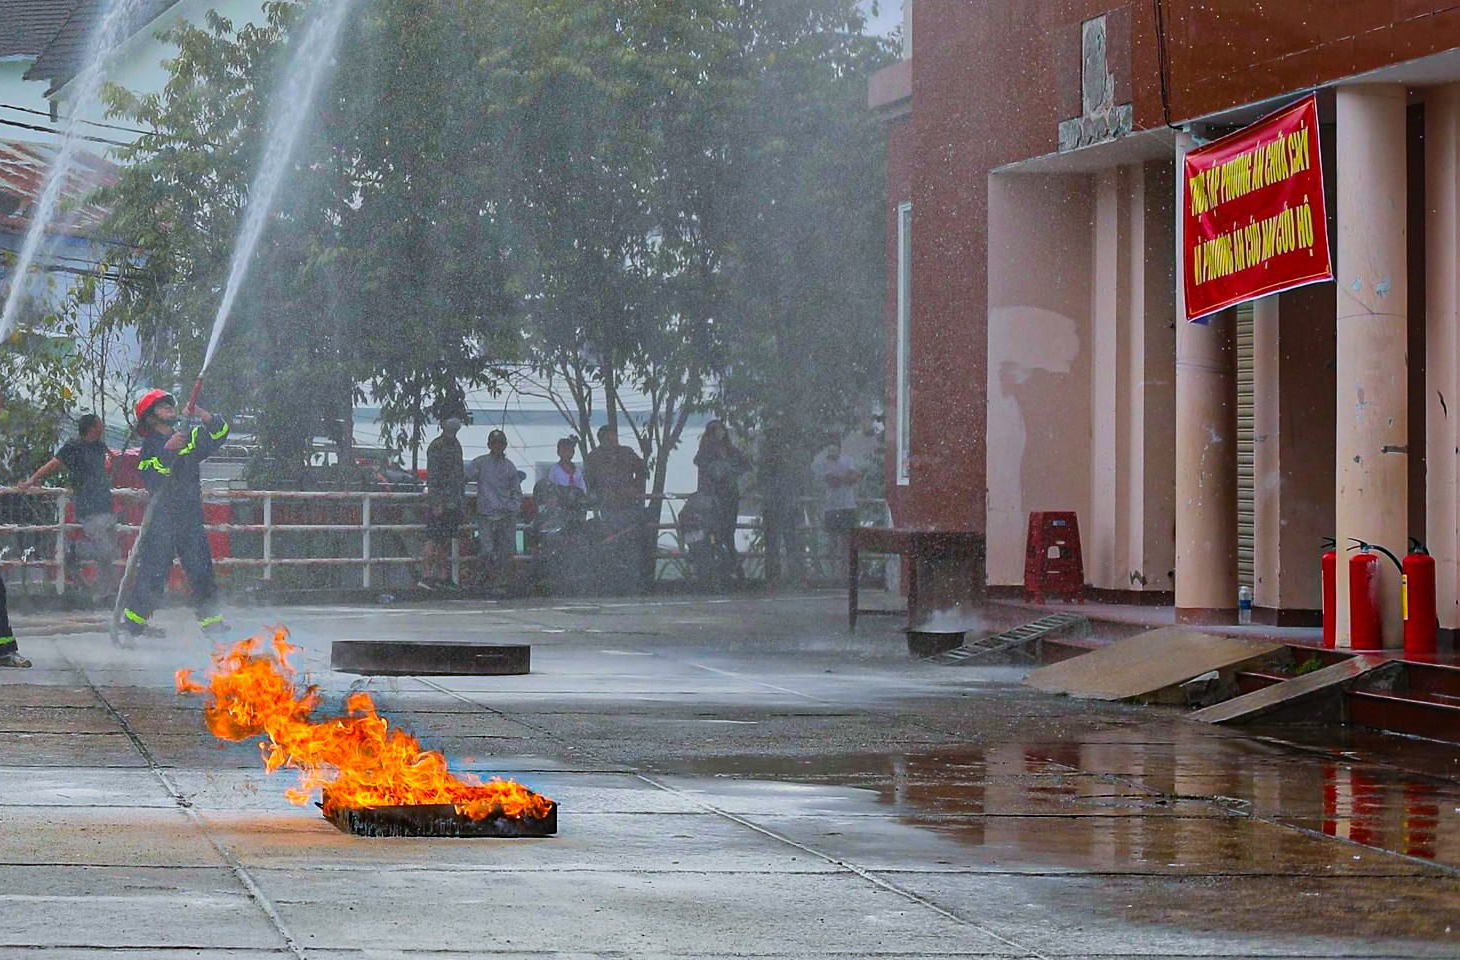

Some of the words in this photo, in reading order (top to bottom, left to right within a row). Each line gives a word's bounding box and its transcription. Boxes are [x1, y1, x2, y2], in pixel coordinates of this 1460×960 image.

[1252, 140, 1265, 191] ÁN
[1233, 221, 1246, 273] ÁN
[1245, 214, 1261, 269] CỨU
[1276, 201, 1295, 256] CỨU
[1296, 193, 1314, 257] HỘ
